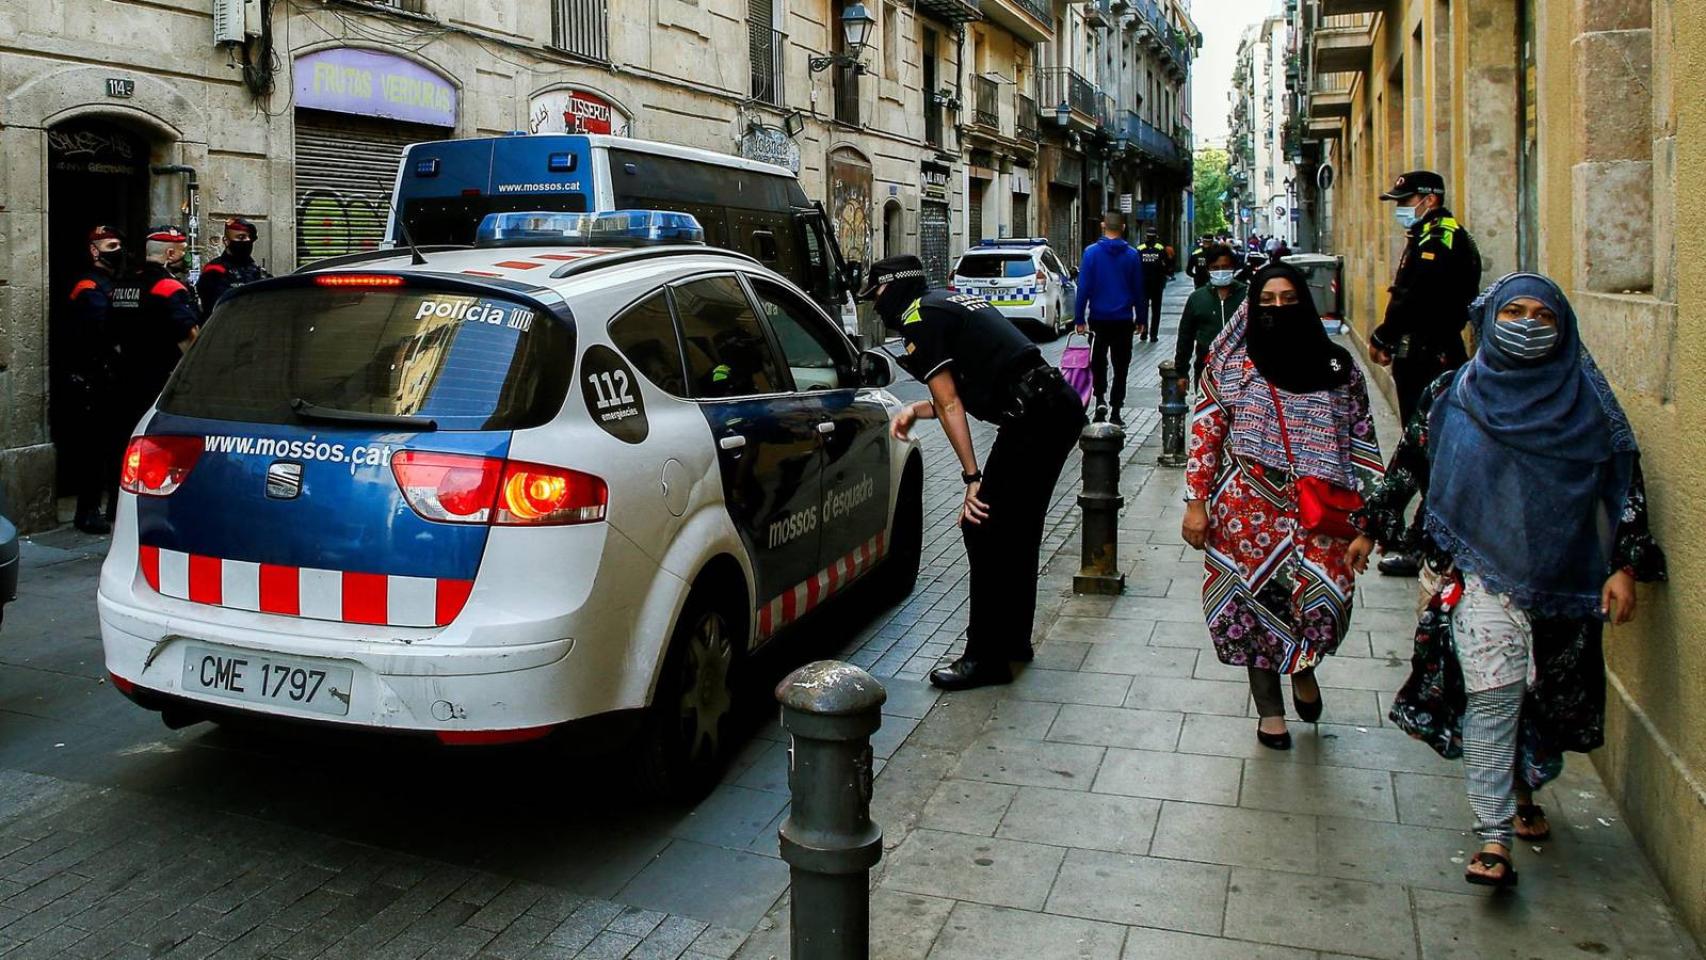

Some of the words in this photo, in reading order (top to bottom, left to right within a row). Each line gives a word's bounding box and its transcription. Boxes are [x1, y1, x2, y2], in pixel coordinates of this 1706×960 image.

[313, 62, 372, 99] FRUTAS
[381, 73, 450, 111] VERDURAS
[498, 181, 580, 192] www.mossos.cat
[113, 288, 140, 300] POLICIA
[415, 300, 505, 326] policia
[588, 369, 634, 409] 112
[204, 435, 391, 467] www.mossos.cat
[769, 506, 817, 549] mossos
[823, 473, 873, 523] d'esquadra
[200, 655, 248, 693] CME
[262, 663, 326, 703] 1797
